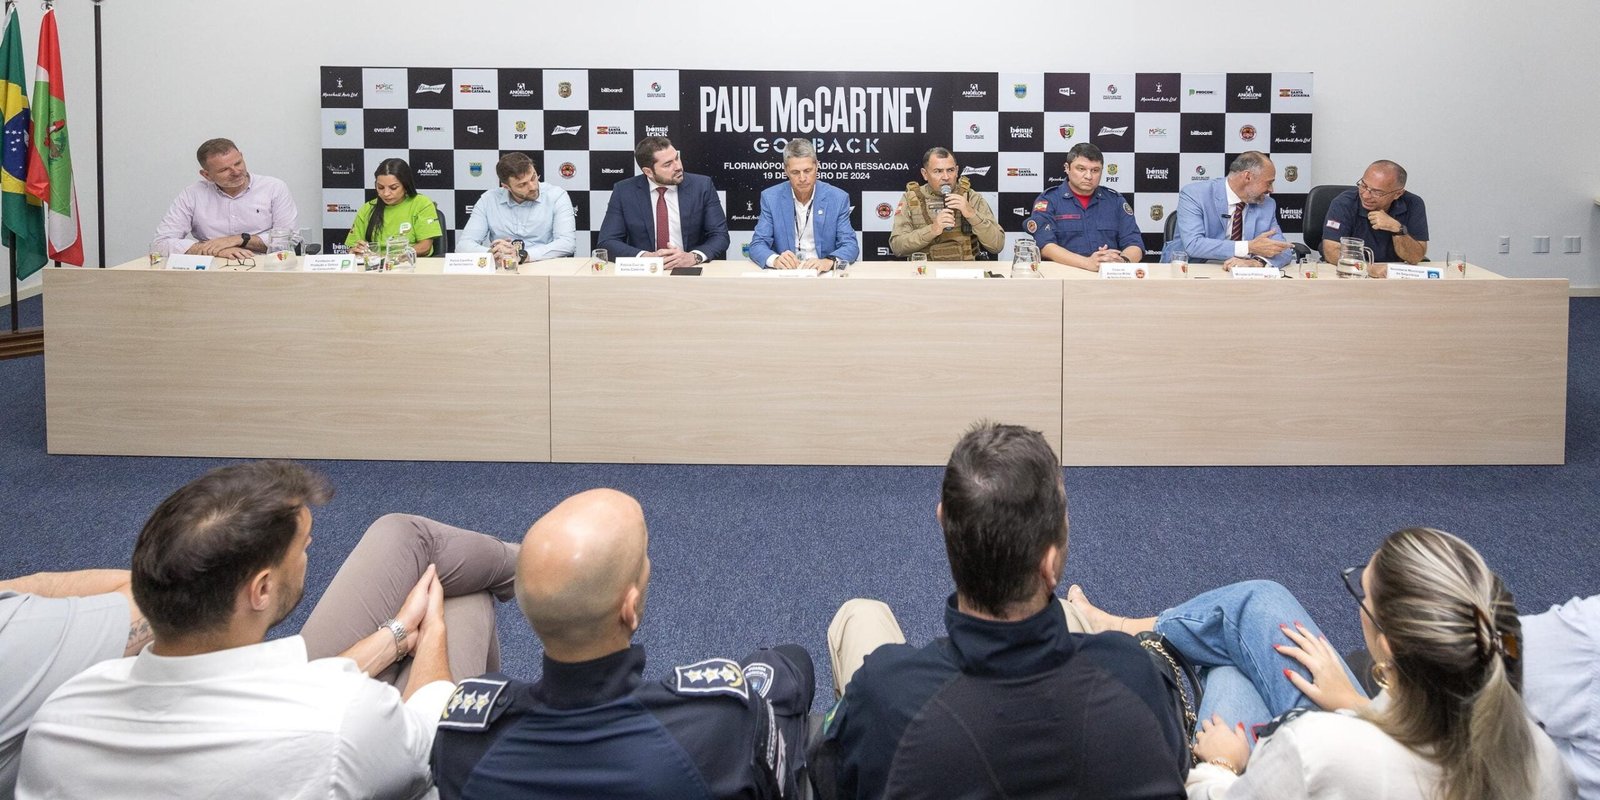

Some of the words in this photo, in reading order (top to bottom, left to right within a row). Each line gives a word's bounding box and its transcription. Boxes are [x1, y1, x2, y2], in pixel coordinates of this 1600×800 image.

[700, 86, 764, 133] PAUL
[770, 86, 932, 134] McCARTNEY
[754, 137, 790, 154] GO
[814, 137, 880, 154] BACK
[724, 160, 786, 170] FLORIANÓPOL
[816, 160, 838, 170] ÁDIO
[840, 162, 853, 170] DA
[855, 162, 909, 170] RESSACADA
[763, 172, 773, 180] 19
[775, 172, 788, 180] DE
[836, 172, 849, 180] DE
[850, 172, 870, 180] 2024
